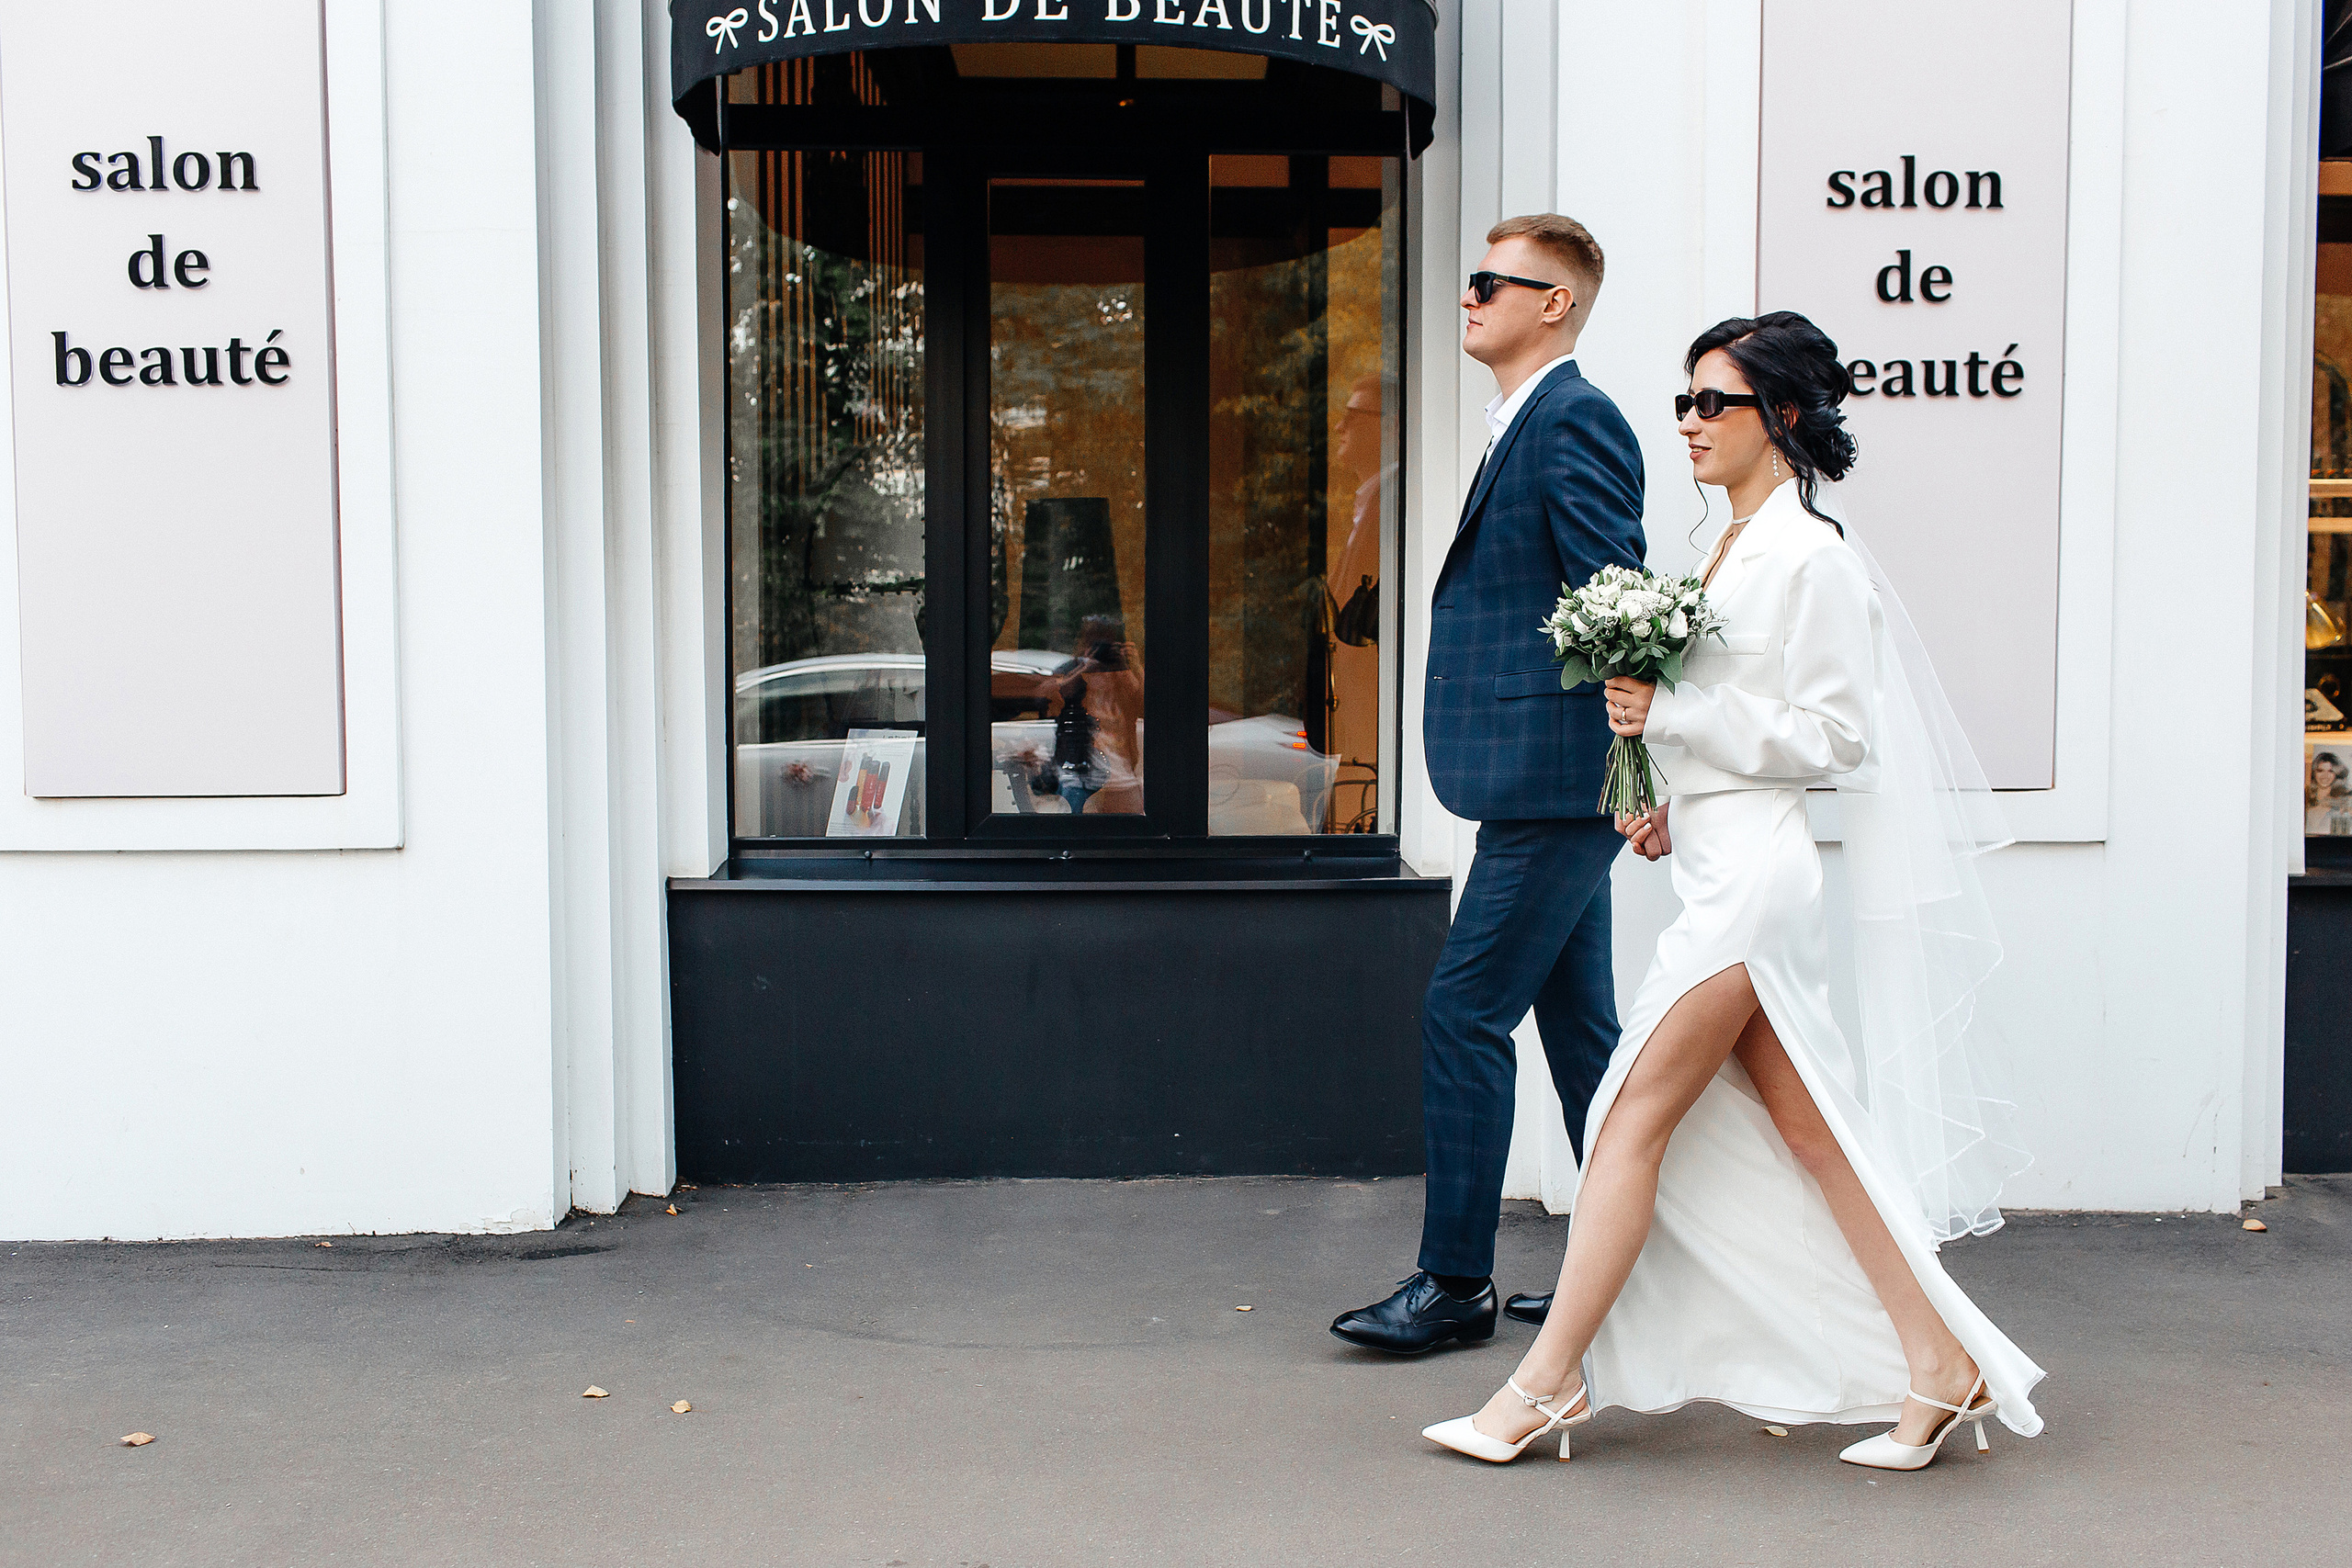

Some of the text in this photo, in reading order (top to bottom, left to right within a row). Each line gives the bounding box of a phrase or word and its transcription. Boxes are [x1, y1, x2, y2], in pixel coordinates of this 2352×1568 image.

[758, 0, 941, 42] SALON
[71, 135, 259, 193] salon
[1826, 154, 2005, 210] salon
[128, 233, 210, 290] de
[1875, 249, 1953, 304] de
[51, 329, 291, 387] beauté
[1846, 343, 2025, 399] eauté
